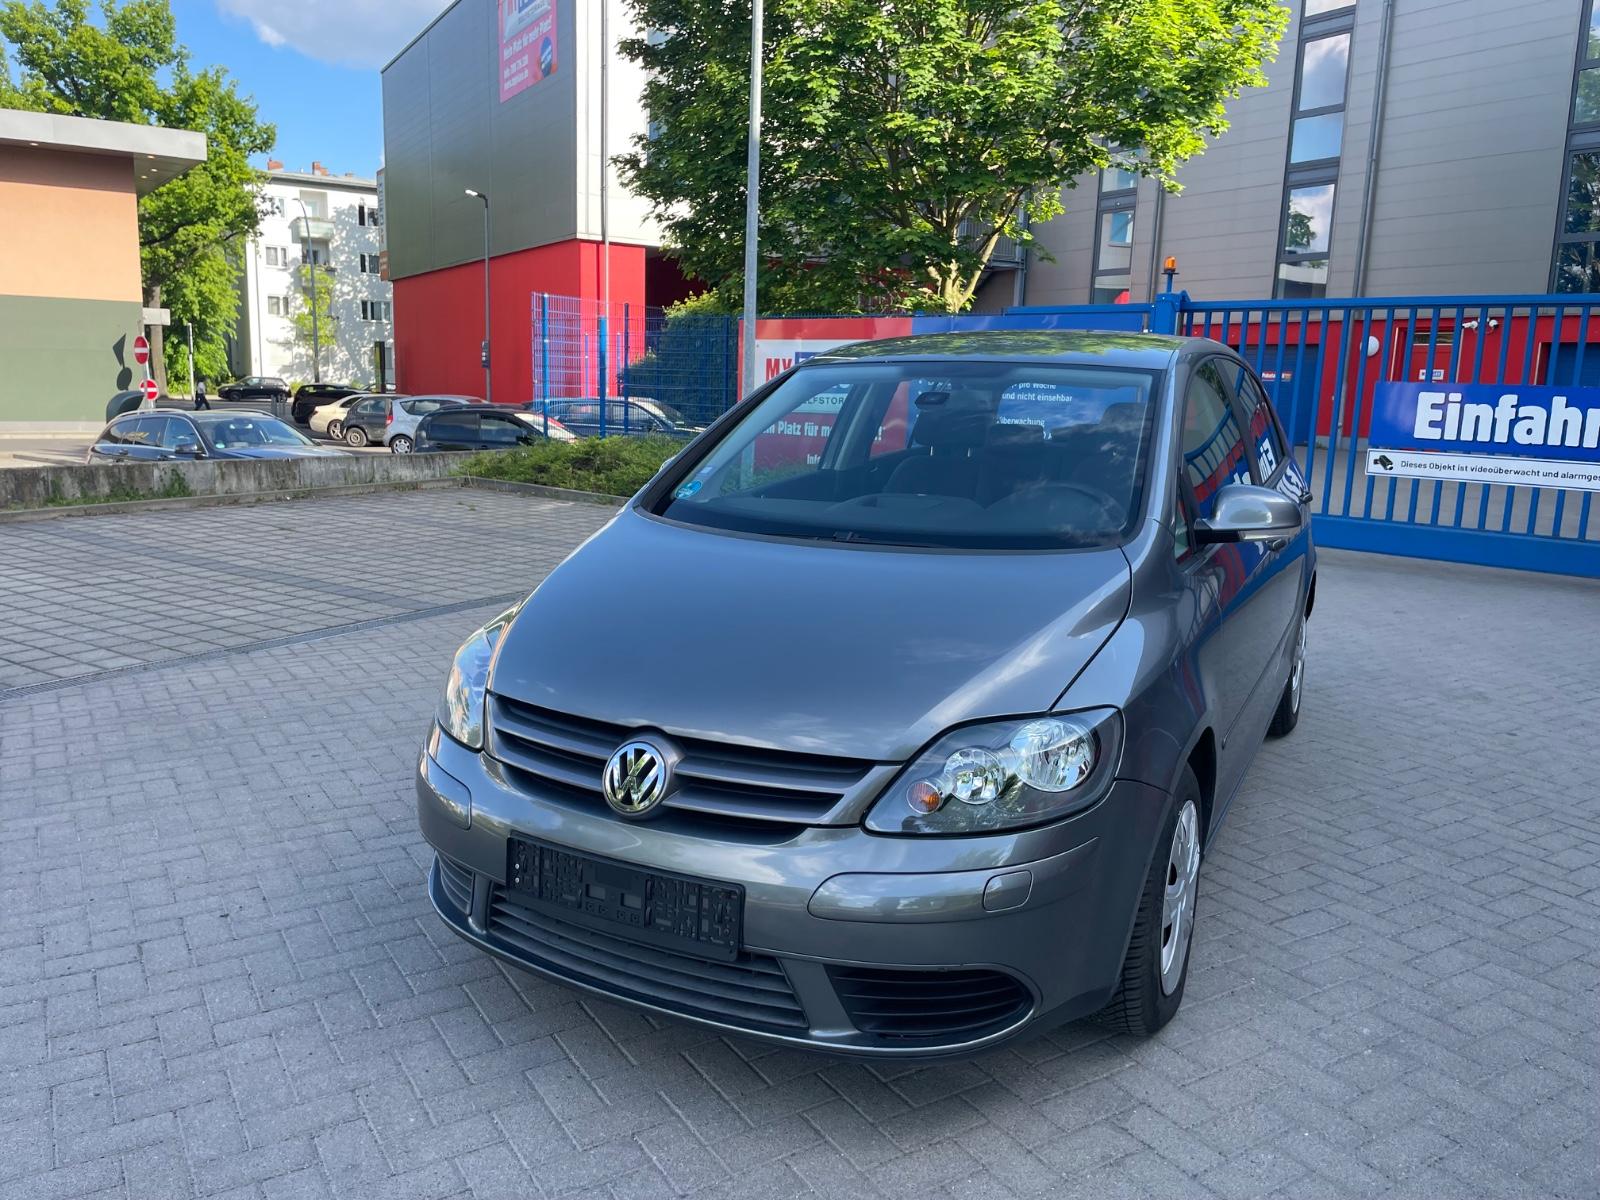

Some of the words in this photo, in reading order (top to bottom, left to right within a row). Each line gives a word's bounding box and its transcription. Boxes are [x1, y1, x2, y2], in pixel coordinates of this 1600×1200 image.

[1001, 392, 1015, 400] und
[1017, 393, 1035, 401] nicht
[1037, 394, 1073, 402] einsehbar
[777, 421, 801, 436] Platz
[804, 422, 818, 437] für
[1400, 460, 1427, 469] Dieses
[1428, 462, 1455, 471] Objekt
[1457, 463, 1468, 472] ist
[1470, 465, 1540, 477] videoüberwacht
